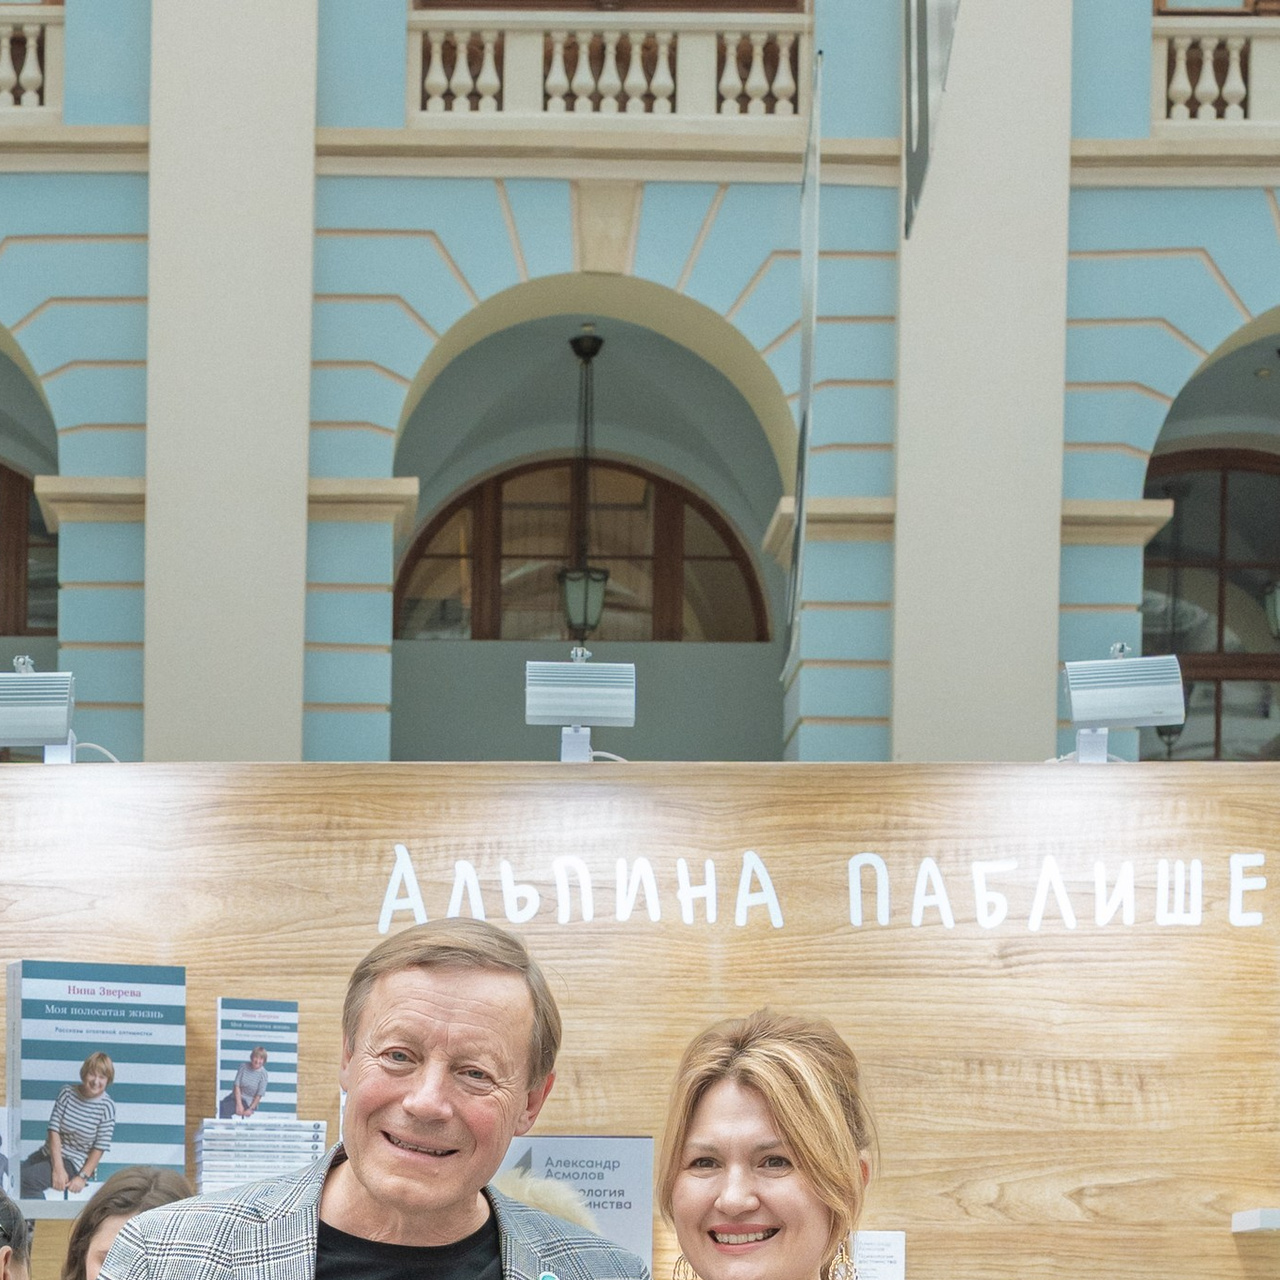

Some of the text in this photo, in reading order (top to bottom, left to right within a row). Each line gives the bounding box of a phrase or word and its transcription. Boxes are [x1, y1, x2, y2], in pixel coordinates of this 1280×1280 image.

[848, 852, 1267, 932] ПАБЛИШЕ
[67, 985, 142, 998] Нина Зверева
[45, 1004, 164, 1019] Моя полосатая жизнь
[545, 1156, 620, 1171] Александр
[545, 1168, 605, 1181] Асмолов
